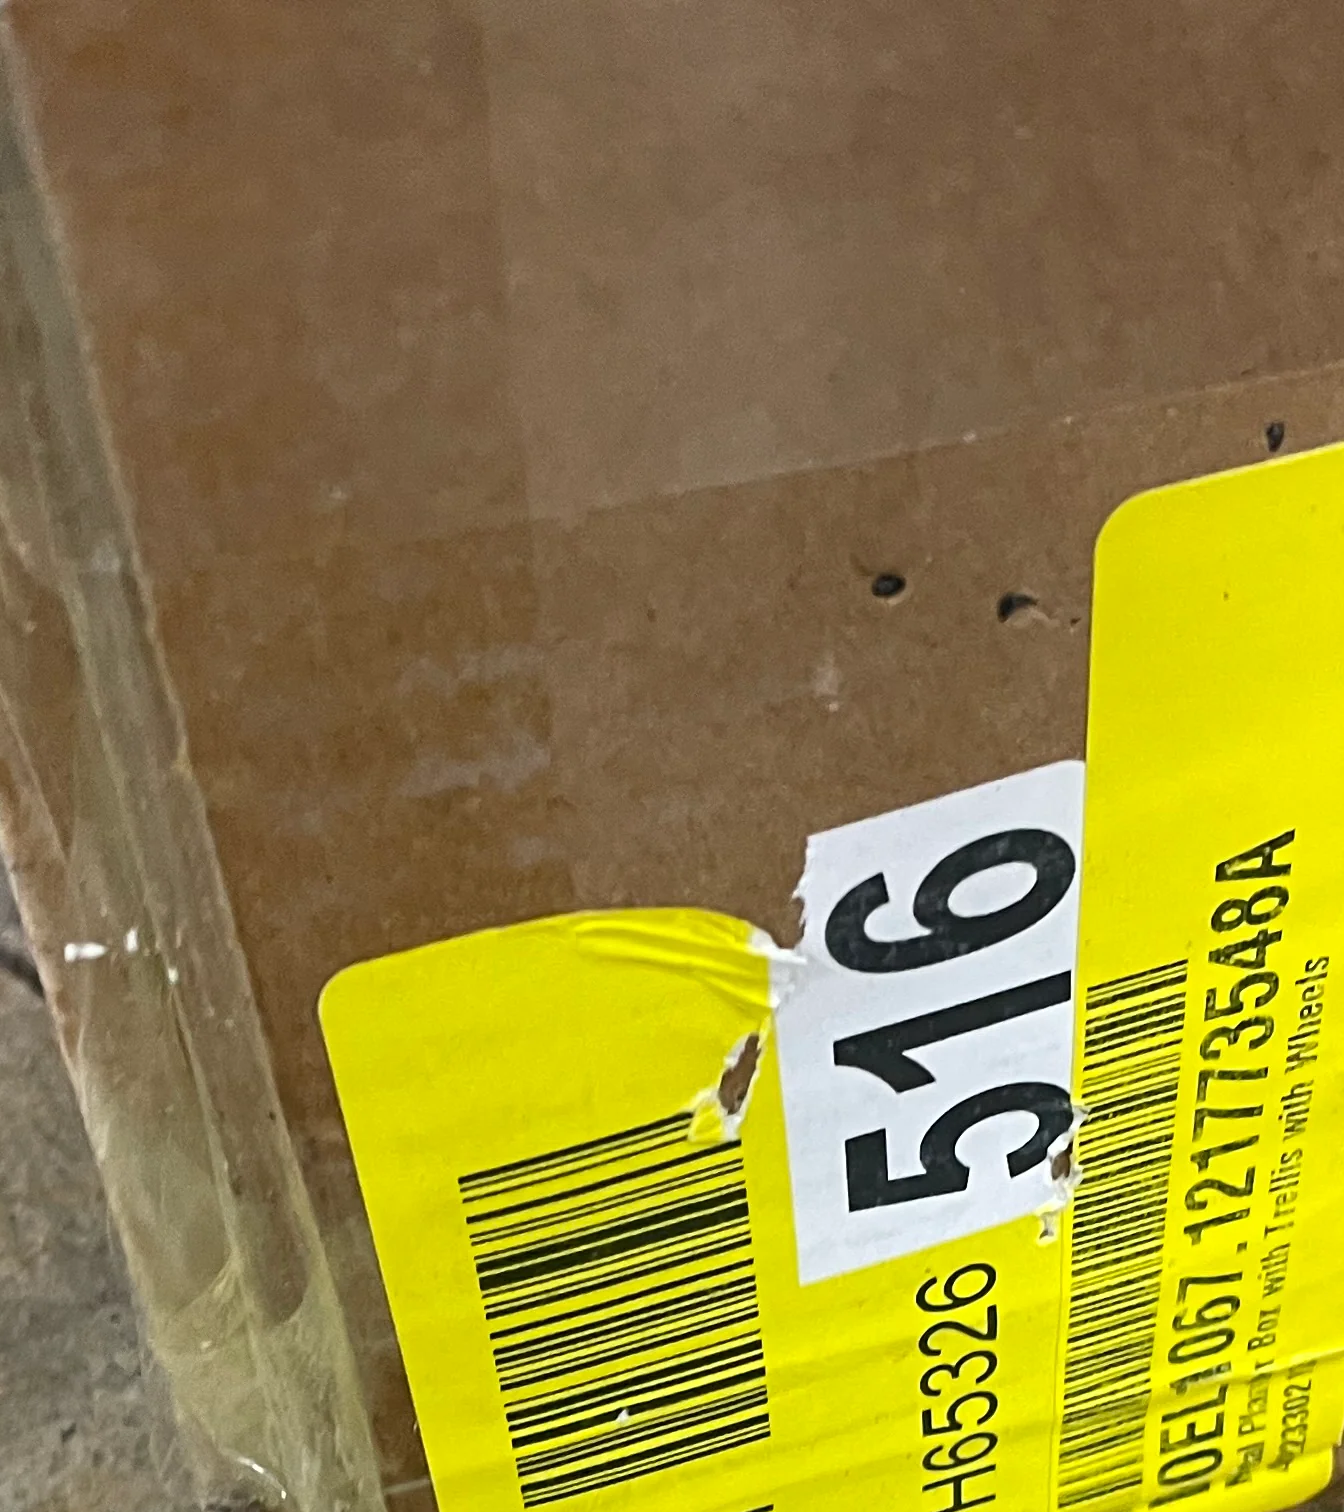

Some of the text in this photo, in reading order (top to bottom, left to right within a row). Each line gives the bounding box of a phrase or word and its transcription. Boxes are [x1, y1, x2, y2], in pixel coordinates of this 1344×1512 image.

[824, 828, 1076, 1213] 516
[1285, 956, 1331, 1076] Wheels
[1279, 1079, 1314, 1143] with
[1264, 1148, 1304, 1240] Trellis
[1258, 1242, 1291, 1298] with
[1247, 1304, 1282, 1351] Box
